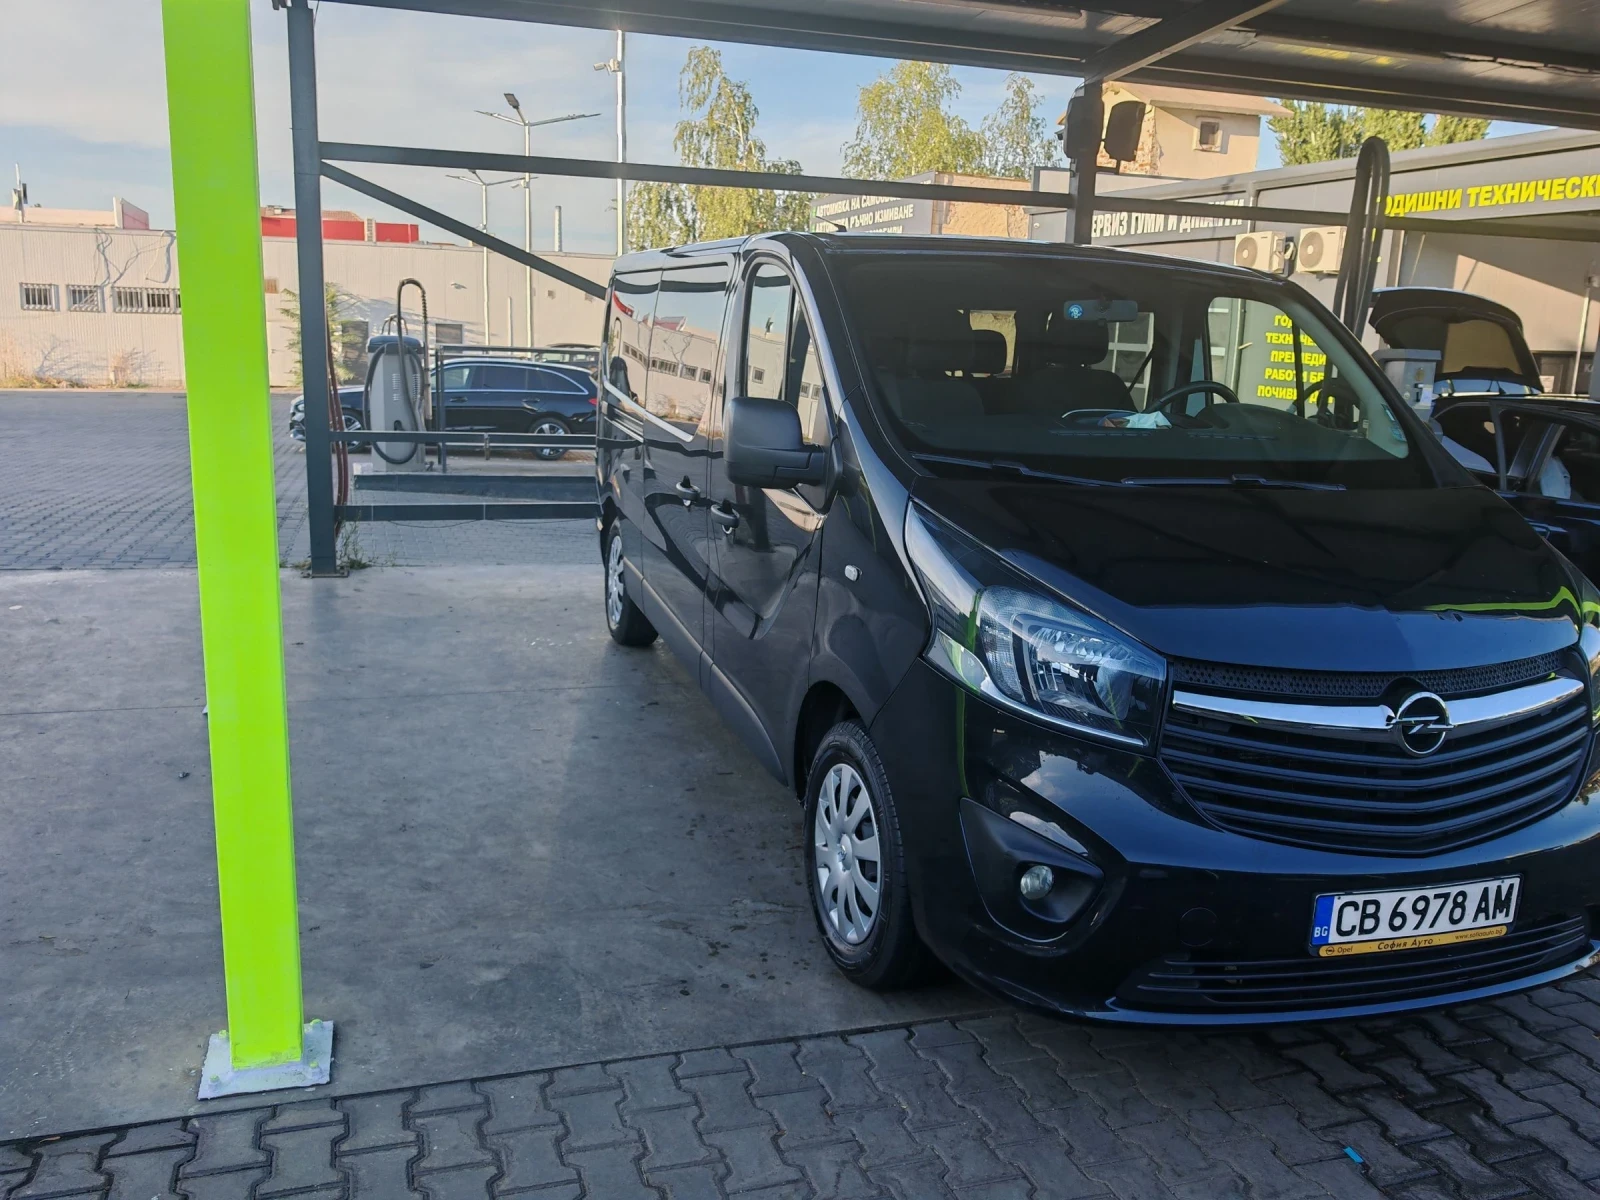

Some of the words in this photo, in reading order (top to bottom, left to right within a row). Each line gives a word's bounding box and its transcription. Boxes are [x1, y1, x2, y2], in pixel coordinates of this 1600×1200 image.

[816, 199, 850, 217] АВТОМИВКА
[851, 196, 861, 211] НА
[1384, 188, 1462, 217] ОДИШНИ
[850, 211, 873, 228] РЪЧНО
[874, 203, 914, 223] ИЗМИВАНЕ
[1091, 212, 1128, 237] ЕРВИЗ
[1130, 212, 1164, 234] ГУМИ
[1167, 215, 1177, 231] И
[1336, 898, 1381, 937] CB
[1388, 890, 1468, 932] 6978
[1472, 882, 1515, 923] AM
[1314, 926, 1328, 938] BG
[1336, 946, 1354, 955] Opel
[1377, 941, 1408, 951] София
[1410, 938, 1434, 948] Ауто
